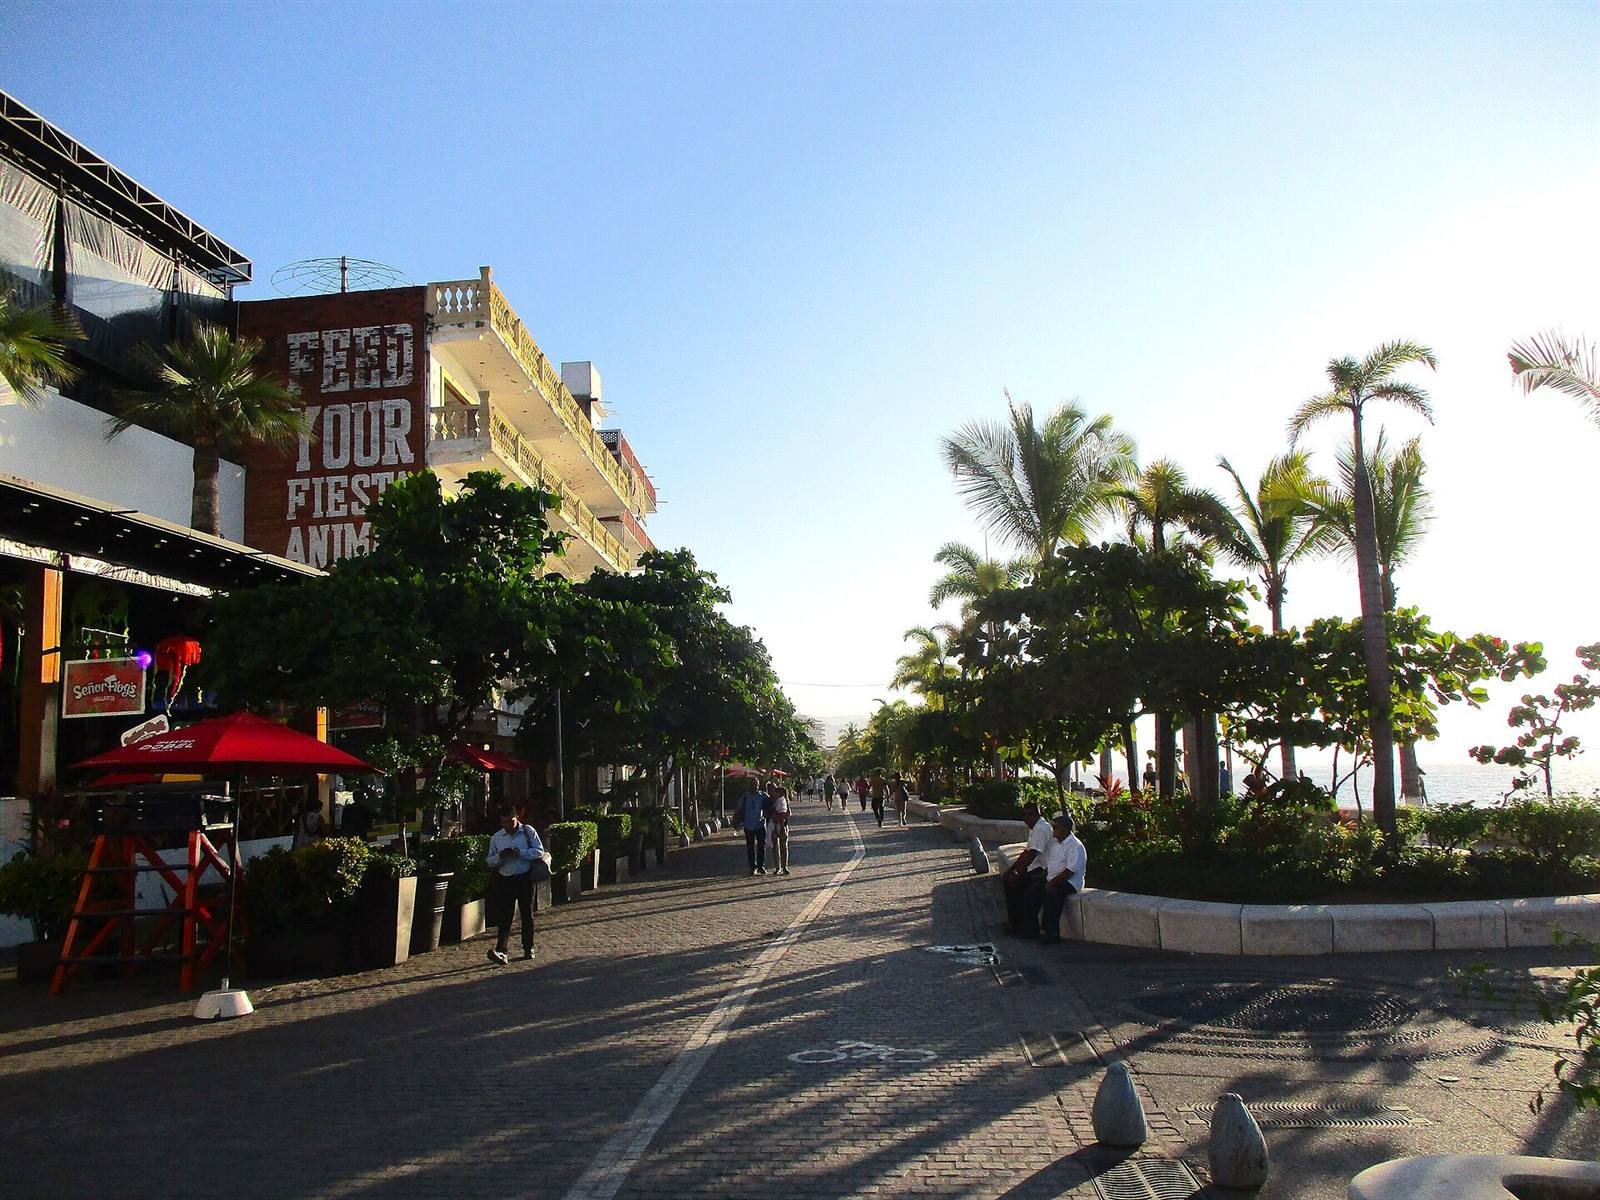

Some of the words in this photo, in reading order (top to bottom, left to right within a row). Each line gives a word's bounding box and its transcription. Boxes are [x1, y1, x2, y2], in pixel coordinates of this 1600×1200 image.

[286, 323, 414, 393] FEED
[291, 398, 415, 472] YOUR
[286, 470, 408, 520] FIEST
[285, 521, 380, 568] ANIM
[73, 682, 106, 699] Señor
